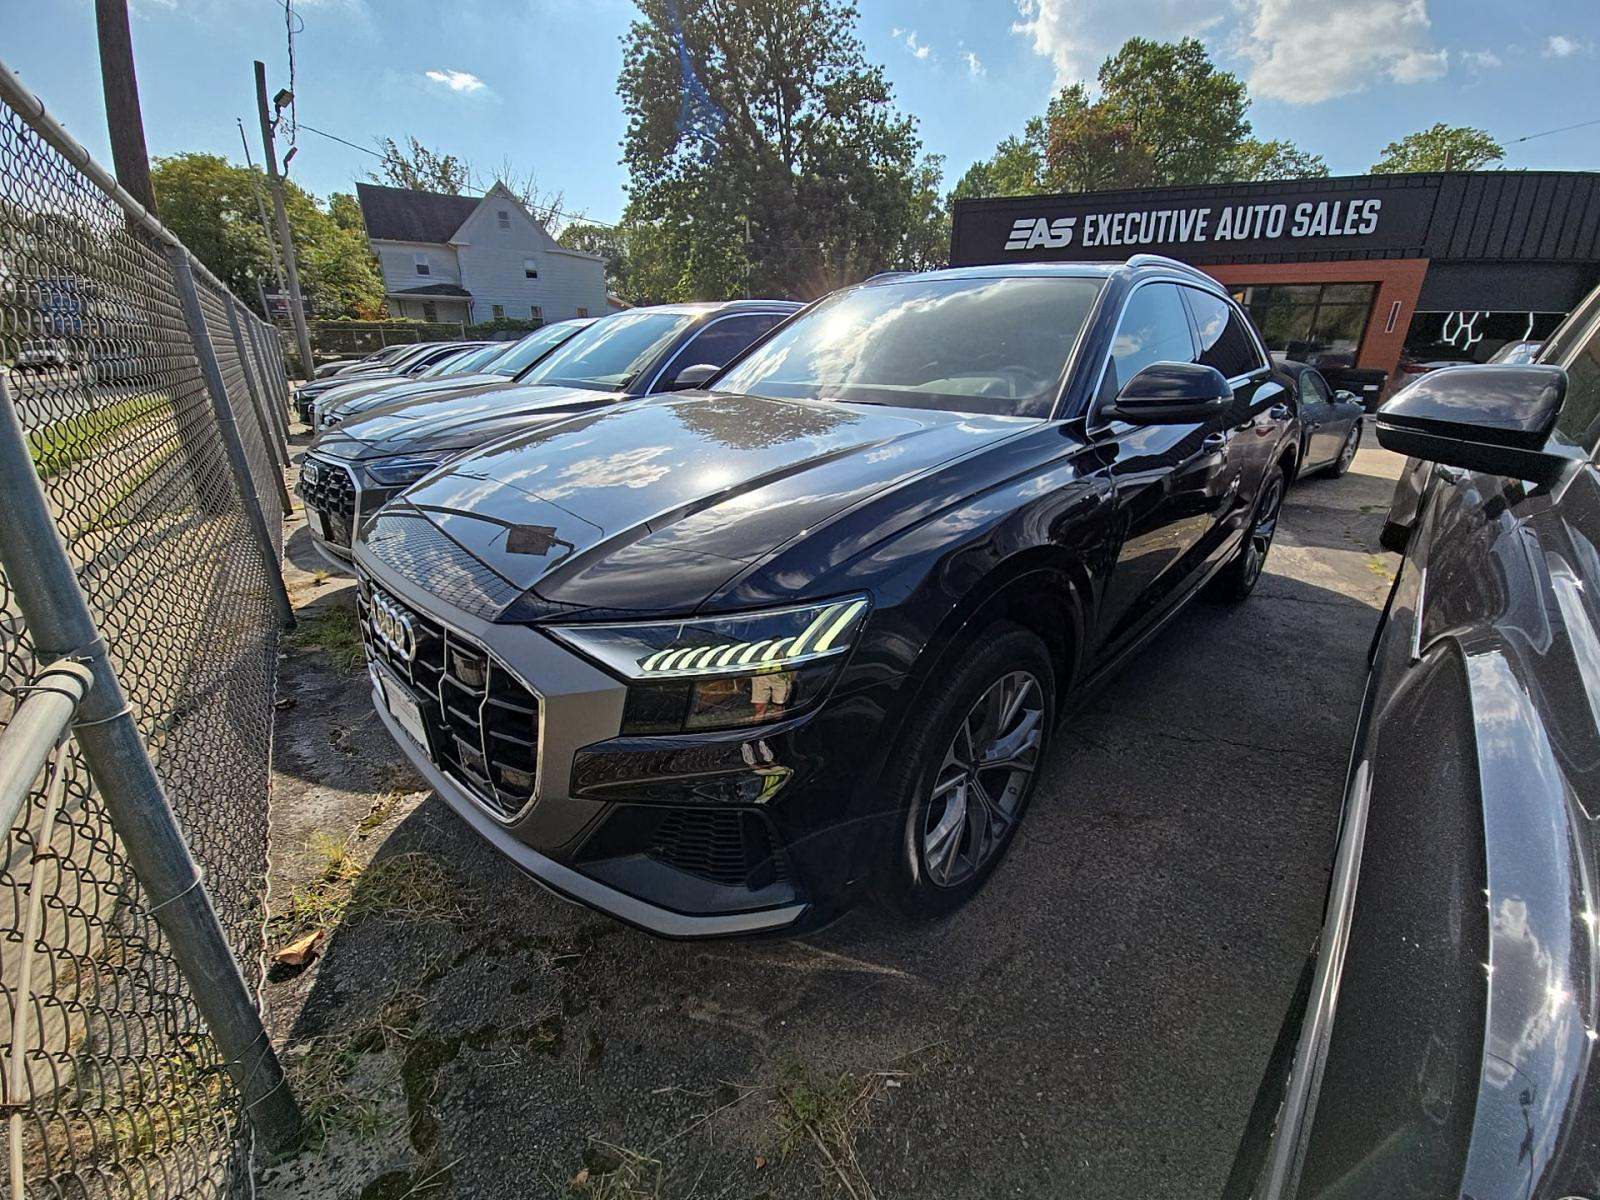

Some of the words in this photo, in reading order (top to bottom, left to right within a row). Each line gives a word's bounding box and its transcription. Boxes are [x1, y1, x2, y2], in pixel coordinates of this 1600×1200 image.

[1004, 217, 1077, 250] EAS
[1082, 208, 1211, 247] EXECUTIVE
[1214, 204, 1287, 241] AUTO
[1291, 199, 1382, 236] SALES
